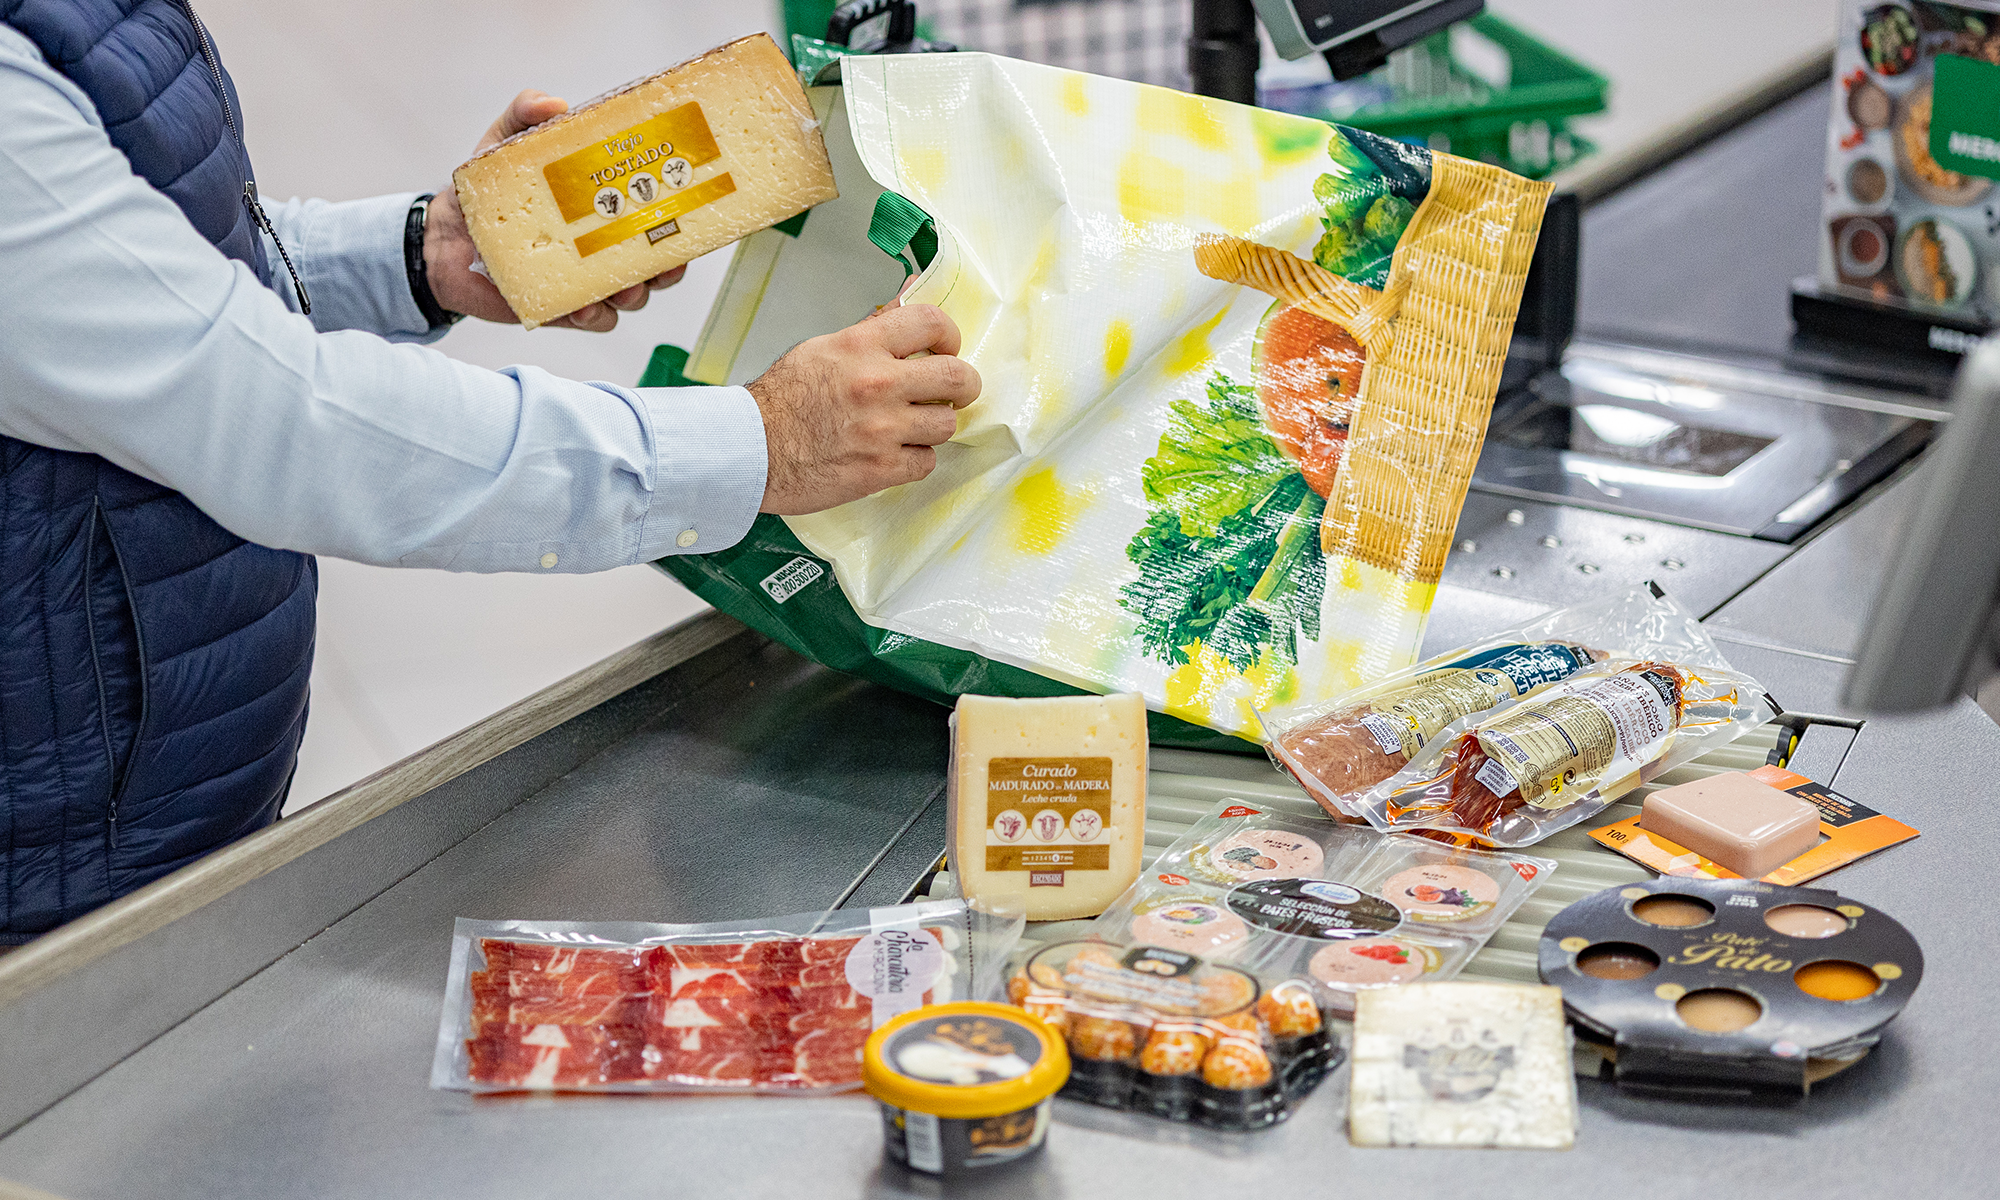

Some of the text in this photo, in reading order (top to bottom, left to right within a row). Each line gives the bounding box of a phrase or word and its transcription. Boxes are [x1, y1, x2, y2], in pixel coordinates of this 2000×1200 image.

[603, 133, 643, 157] Viejo
[590, 141, 674, 187] TOSTADO
[773, 558, 809, 582] MERCADONA
[1634, 706, 1651, 745] PORCO
[1636, 695, 1658, 738] IBÉRICO
[1022, 764, 1077, 778] Curado
[989, 780, 1055, 791] MADURADO
[1063, 780, 1110, 790] MADERA
[1021, 794, 1077, 803] Leche cruda
[1260, 904, 1297, 919] PATÉS
[1279, 898, 1351, 918] SELECCIÓN DE
[1667, 944, 1793, 973] Pato
